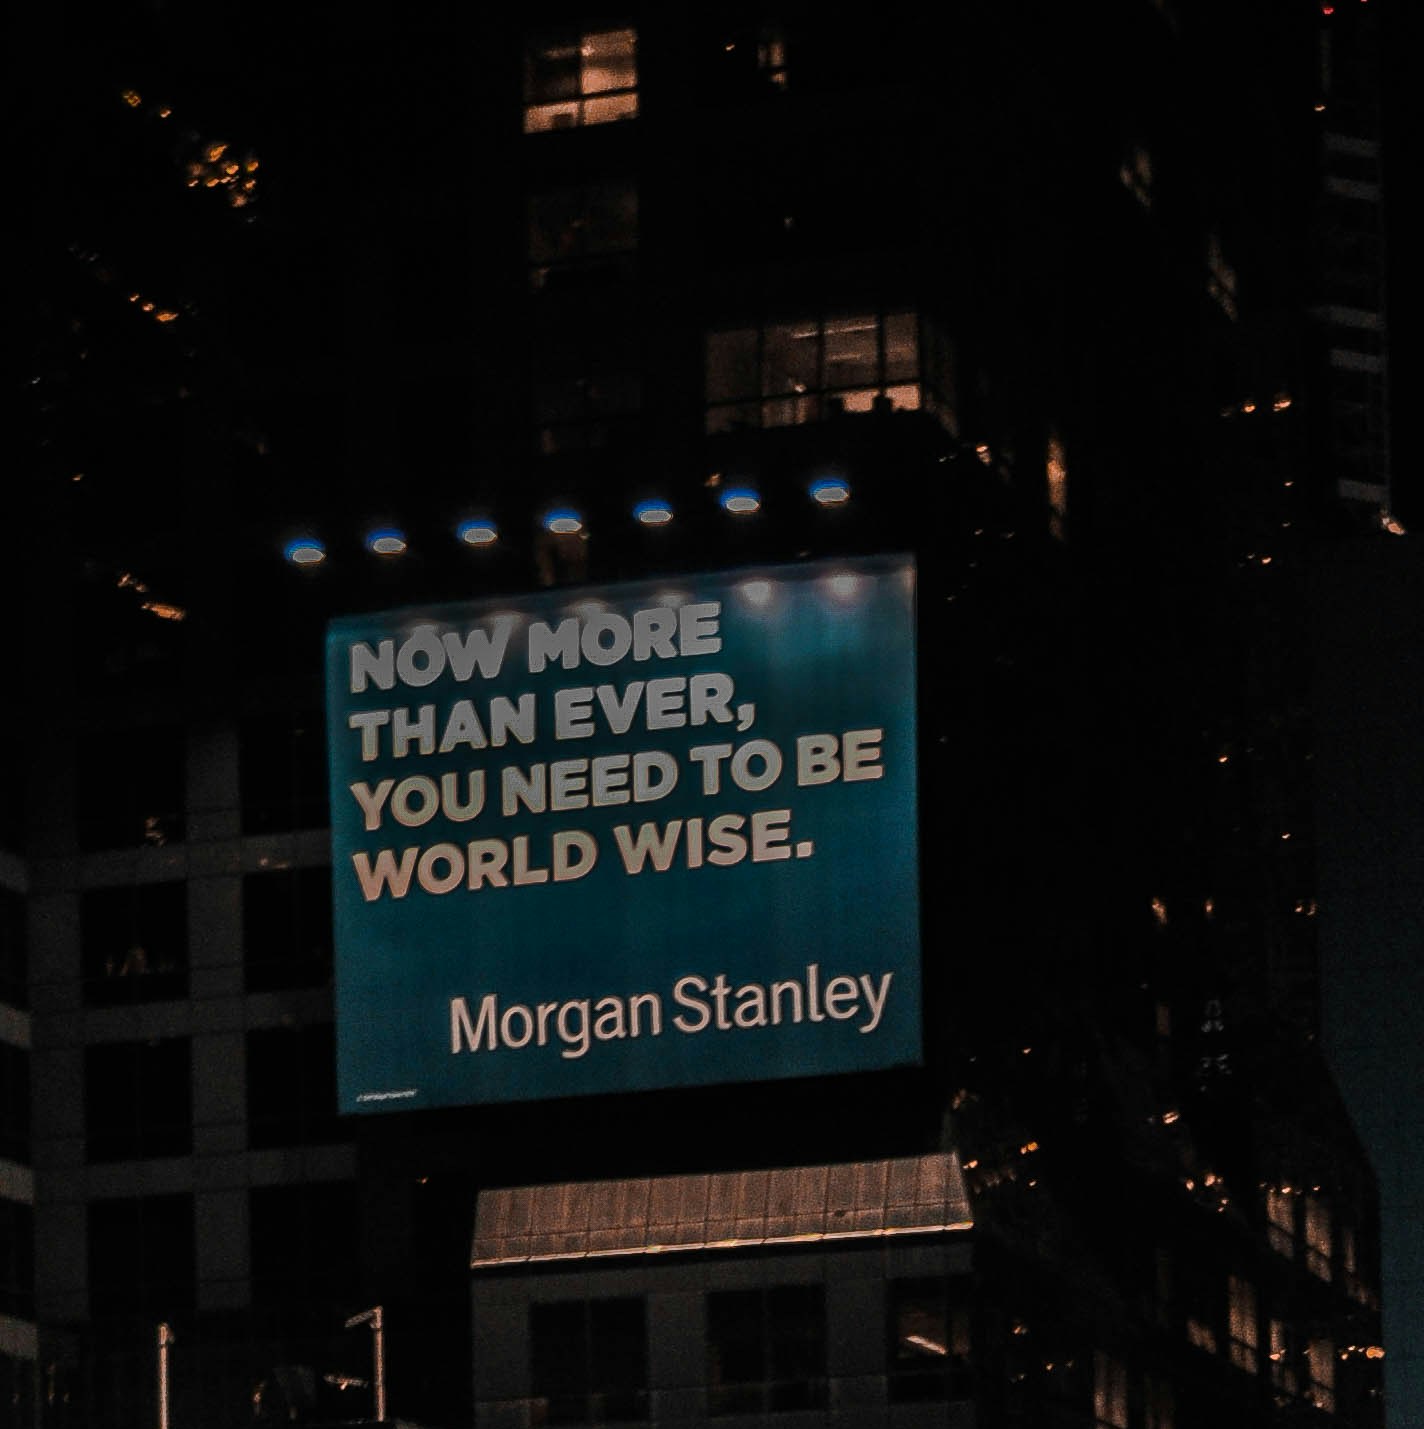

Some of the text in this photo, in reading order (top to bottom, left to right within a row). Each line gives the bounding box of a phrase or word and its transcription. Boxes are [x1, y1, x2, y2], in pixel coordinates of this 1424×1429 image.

[348, 601, 722, 694] NOW MORE
[348, 672, 757, 761] THAN EVER,
[350, 728, 885, 832] YOU NEED TO BE
[352, 809, 815, 901] WORLD WISE.
[449, 963, 896, 1060] Morgan Stanley
